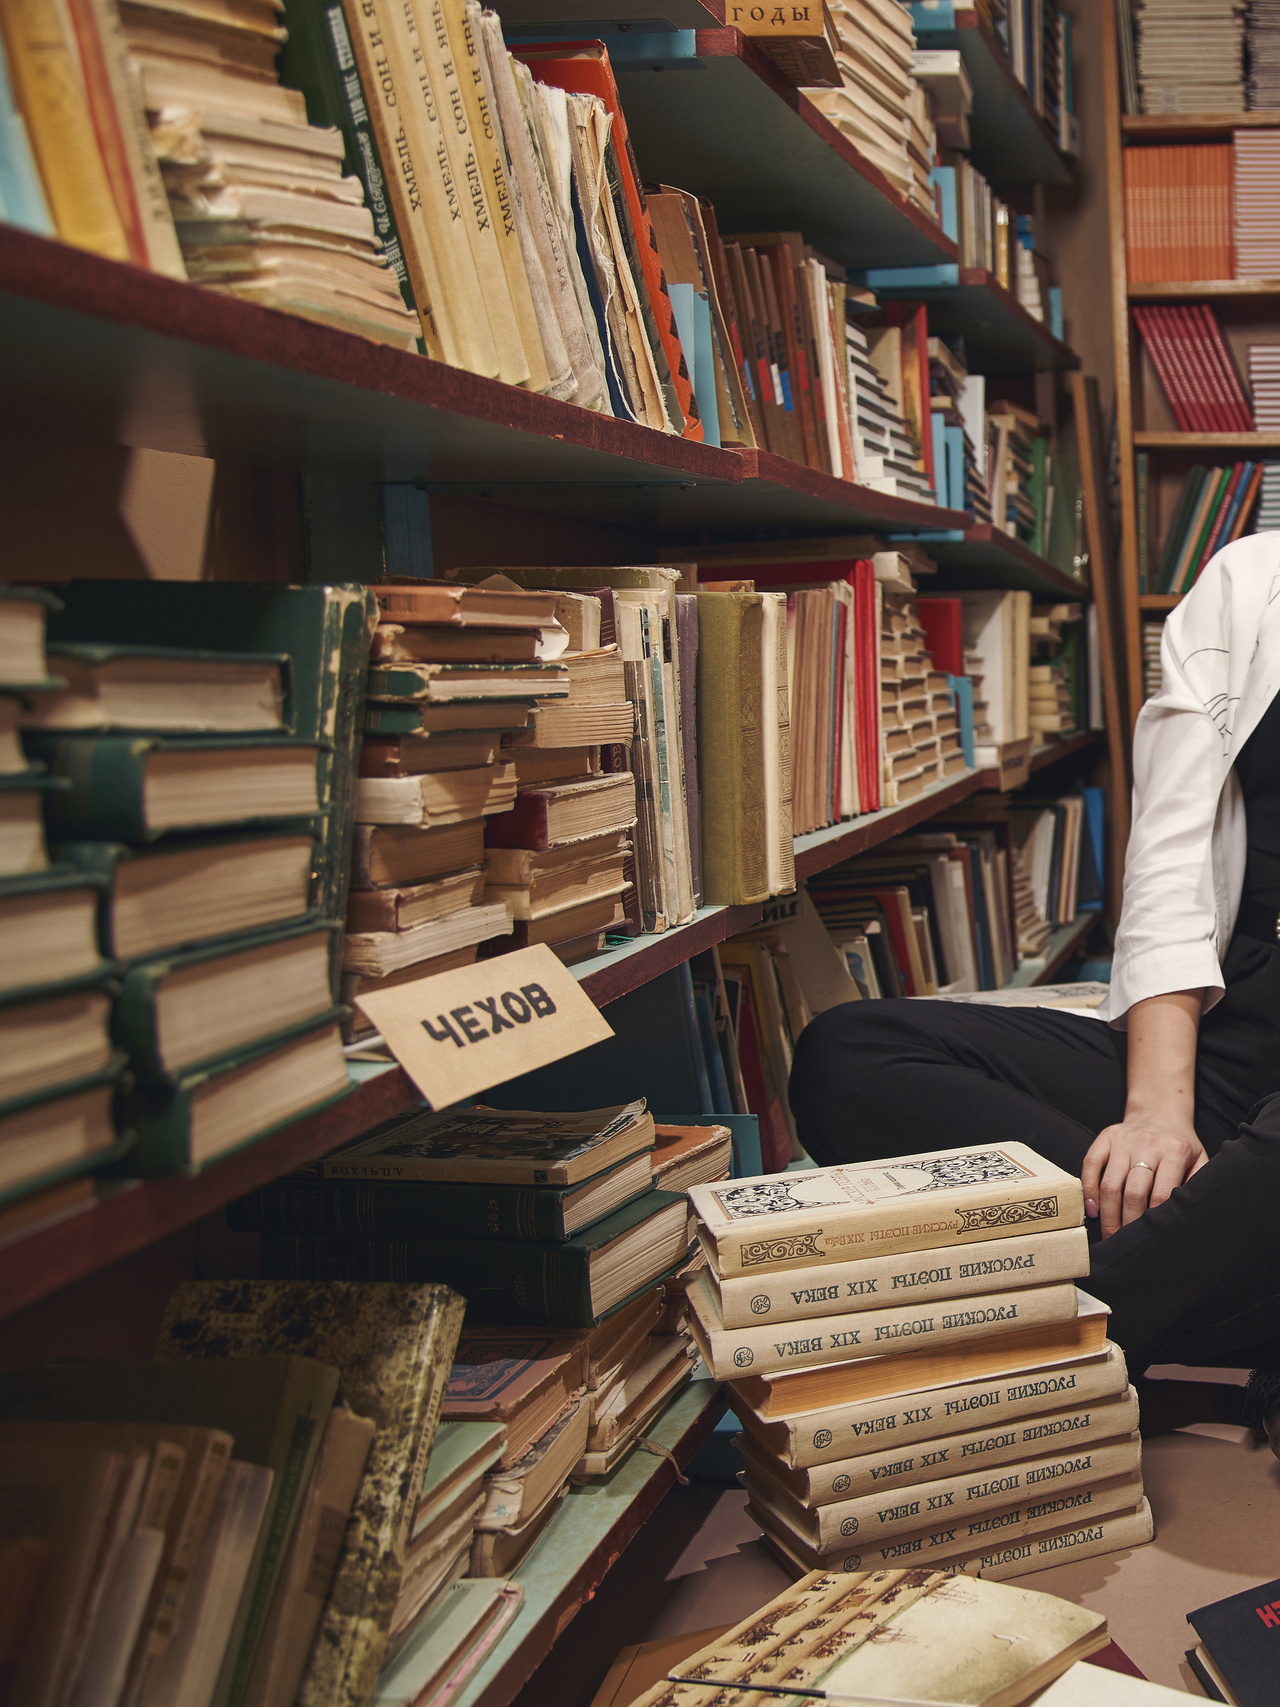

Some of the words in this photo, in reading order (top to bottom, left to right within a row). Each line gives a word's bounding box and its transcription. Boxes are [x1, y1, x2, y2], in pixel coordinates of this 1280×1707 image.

[732, 7, 810, 26] ГОДЫ
[369, 30, 383, 48] И
[412, 48, 423, 64] И
[443, 63, 455, 78] И
[472, 69, 482, 86] И
[376, 61, 397, 107] СОН
[419, 75, 437, 123] СОН
[450, 88, 468, 135] СОН
[478, 95, 494, 140] СОН
[396, 129, 422, 212] ХМЕЛЬ
[437, 141, 462, 222] ХМЕЛЬ
[465, 152, 491, 233] ХМЕЛЬ
[493, 158, 516, 237] ХМЕЛЬ
[421, 983, 557, 1048] ЧЕХОВ
[869, 1227, 910, 1242] ПОЭТЫ
[912, 1219, 960, 1236] РУССКИЕ
[847, 1233, 866, 1246] XIX
[959, 1253, 1036, 1277] РУССКИЕ
[847, 1278, 878, 1296] XIX
[891, 1266, 952, 1289] ПОЭТЫ
[791, 1285, 839, 1305] ВЕКА
[942, 1304, 1018, 1329] РУССКИЕ
[830, 1330, 861, 1348] XIX
[874, 1318, 935, 1341] ПОЭТЫ
[773, 1337, 823, 1358] ВЕКА
[1007, 1374, 1077, 1399] РУССКИЕ
[944, 1391, 1000, 1415] ПОЭТЫ
[851, 1416, 897, 1436] ВЕКА
[903, 1407, 933, 1425] XIX
[1022, 1414, 1091, 1442] РУССКИЕ
[961, 1433, 1016, 1457] ПОЭТЫ
[869, 1458, 914, 1480] ВЕКА
[920, 1449, 949, 1468] XIX
[1026, 1456, 1092, 1485] РУССКИЕ
[966, 1476, 1020, 1500] ПОЭТЫ
[877, 1502, 920, 1523] ВЕКА
[926, 1492, 955, 1510] XIX
[1027, 1491, 1093, 1520] РУССКИЕ
[967, 1510, 1021, 1536] ПОЭТЫ
[929, 1528, 956, 1547] XIX
[1038, 1526, 1104, 1554] РУССКИЕ
[879, 1539, 922, 1560] ВЕКА
[980, 1544, 1032, 1569] ПОЭТЫ
